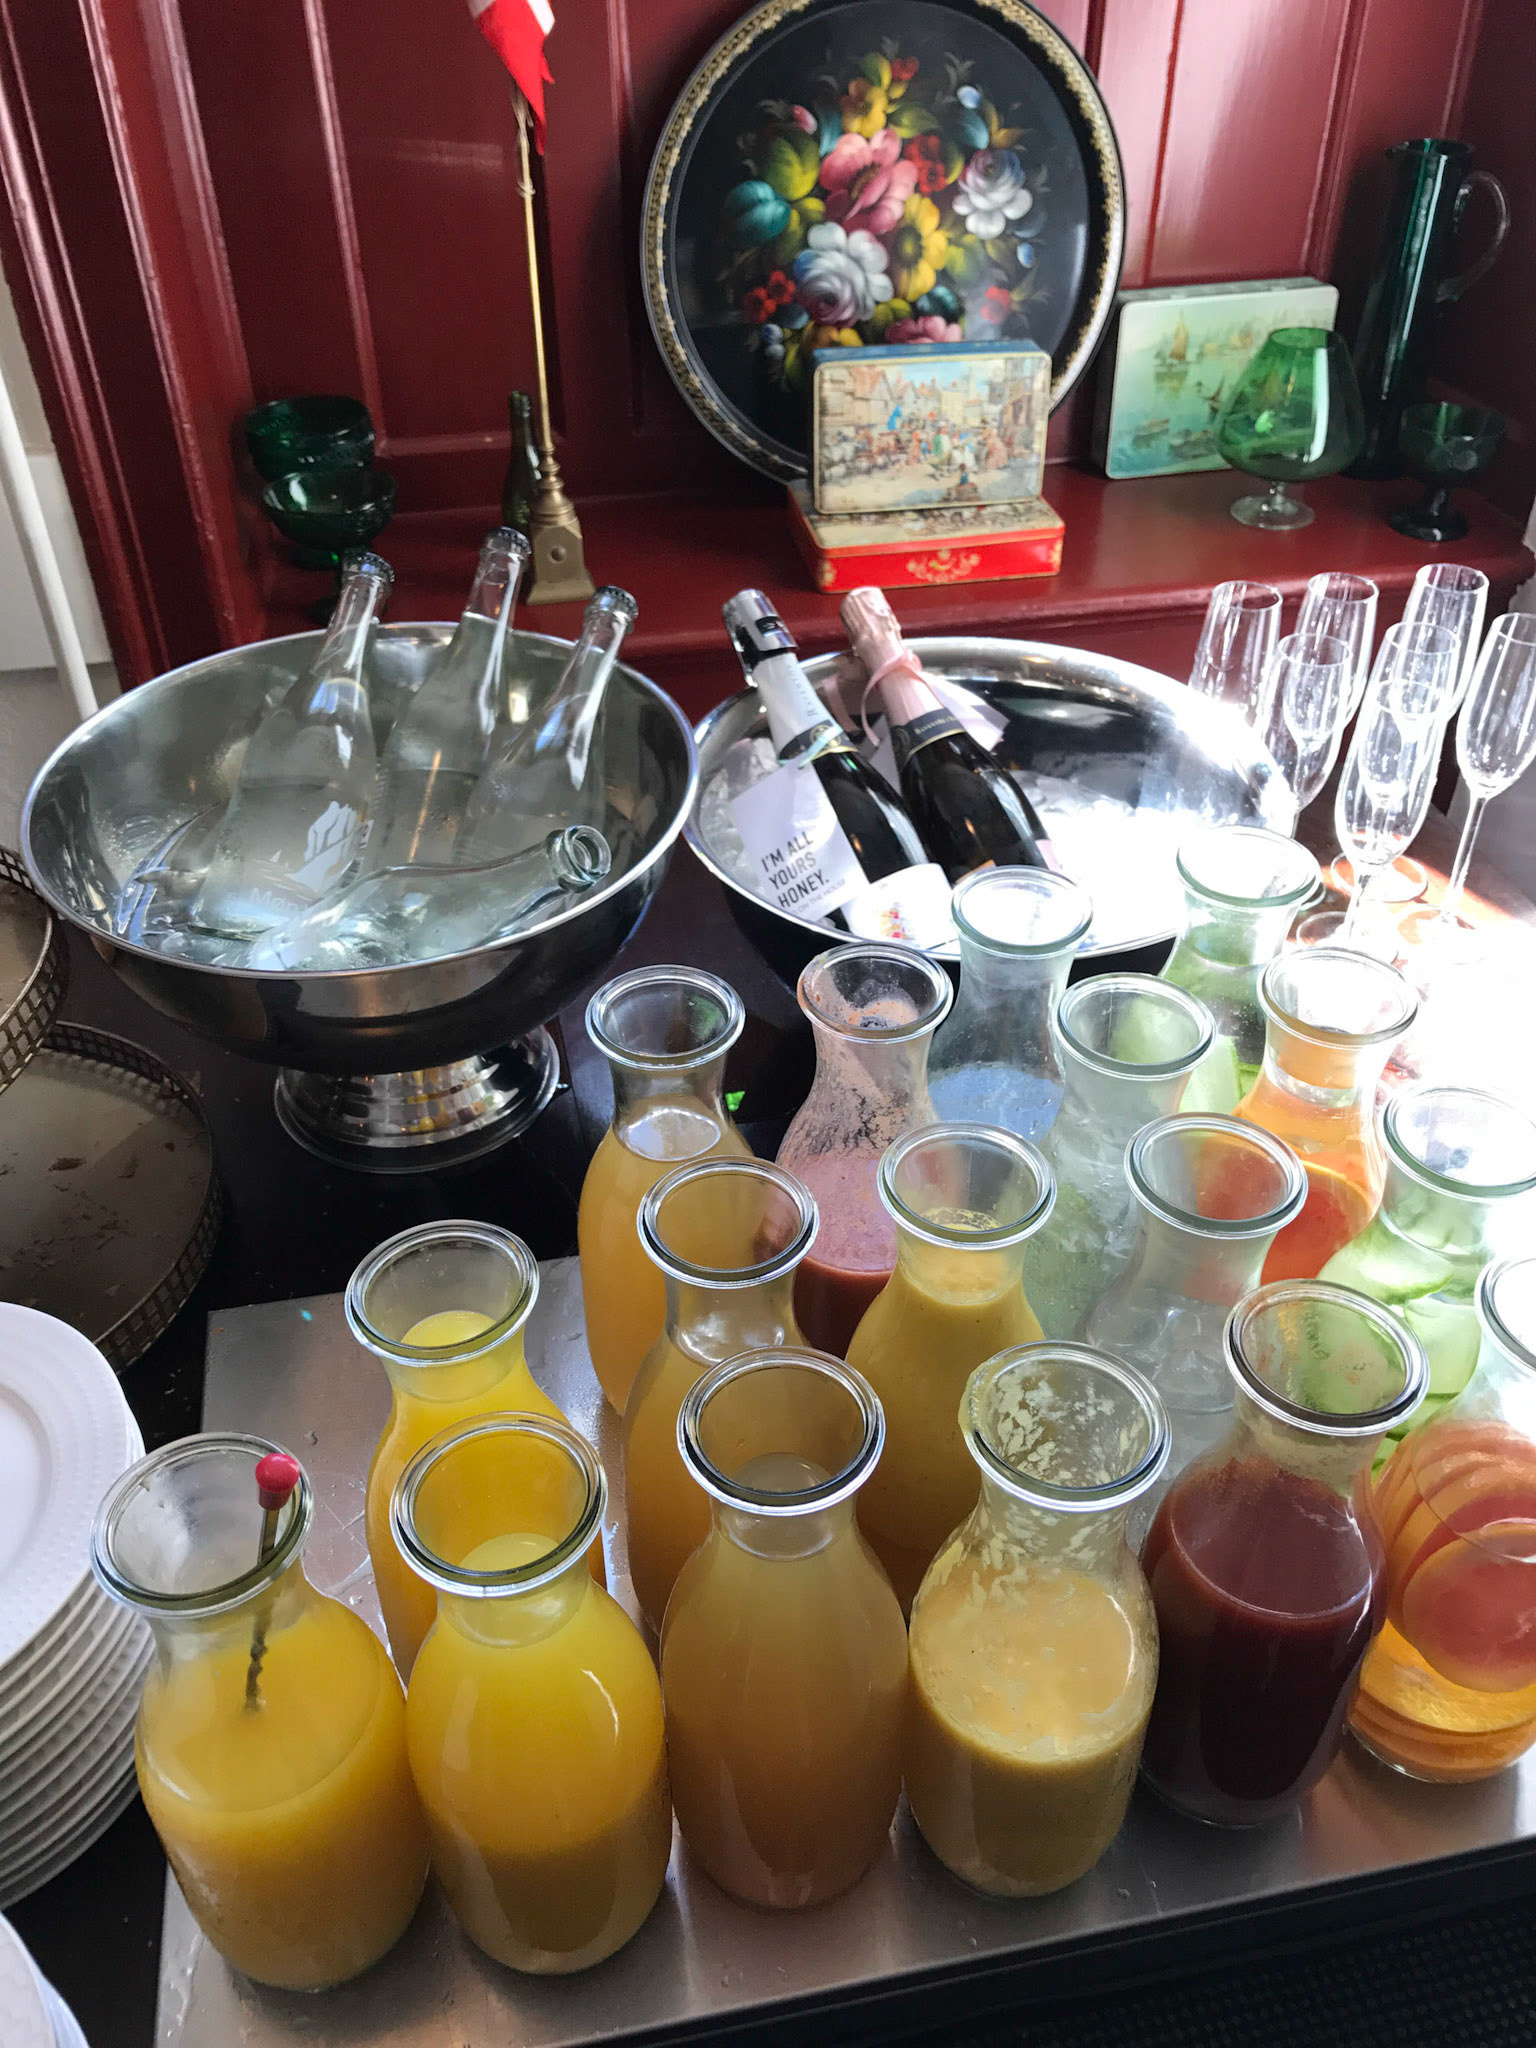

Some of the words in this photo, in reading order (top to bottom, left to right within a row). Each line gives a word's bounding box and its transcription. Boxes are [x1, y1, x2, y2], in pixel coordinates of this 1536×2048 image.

[761, 848, 785, 872] I'M
[787, 831, 814, 857] ALL
[768, 852, 817, 890] YOURS
[777, 868, 829, 908] HONEY.
